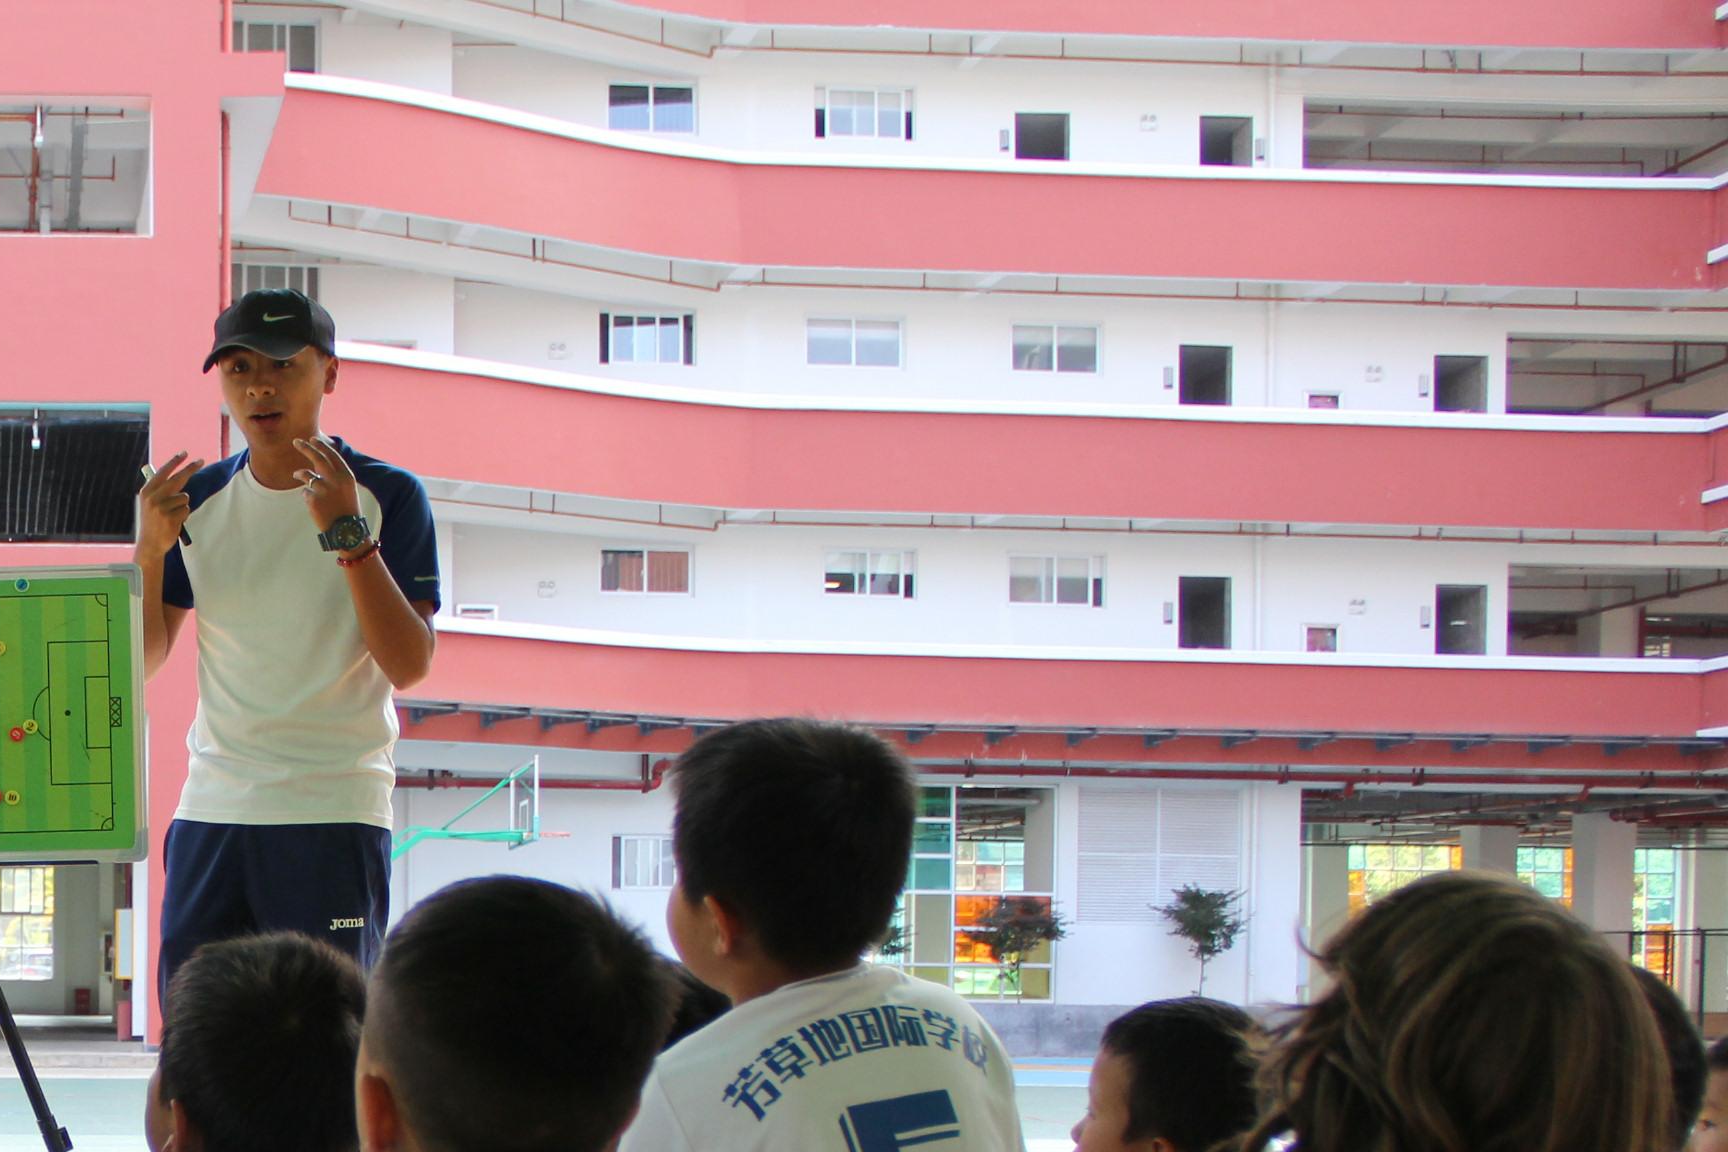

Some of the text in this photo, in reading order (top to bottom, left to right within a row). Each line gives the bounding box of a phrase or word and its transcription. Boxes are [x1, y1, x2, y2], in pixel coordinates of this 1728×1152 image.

[722, 1005, 988, 1122] 芳草地国际学校
